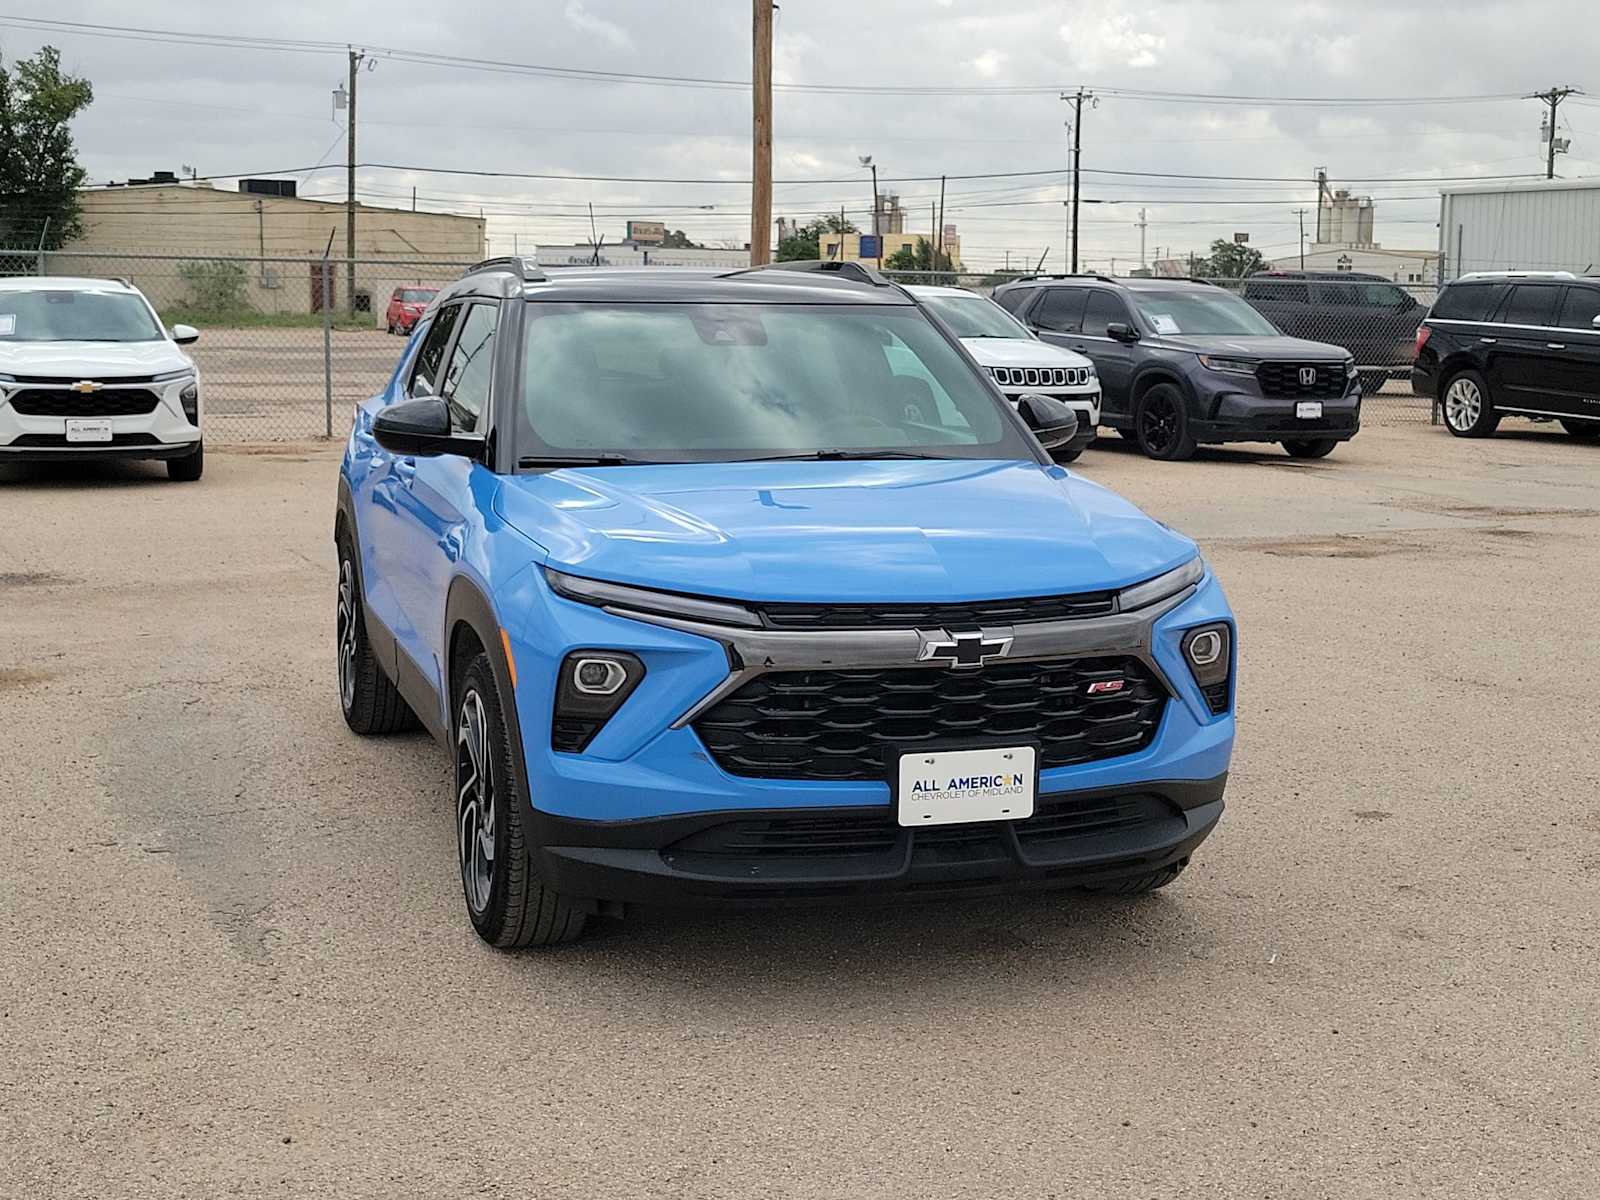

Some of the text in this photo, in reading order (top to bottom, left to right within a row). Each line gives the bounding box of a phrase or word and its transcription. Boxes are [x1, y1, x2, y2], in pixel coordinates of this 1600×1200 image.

[1087, 680, 1124, 694] RS
[912, 773, 1023, 793] ALL AMERICN
[911, 786, 1023, 801] CHEVROLET OF MIDLAND
